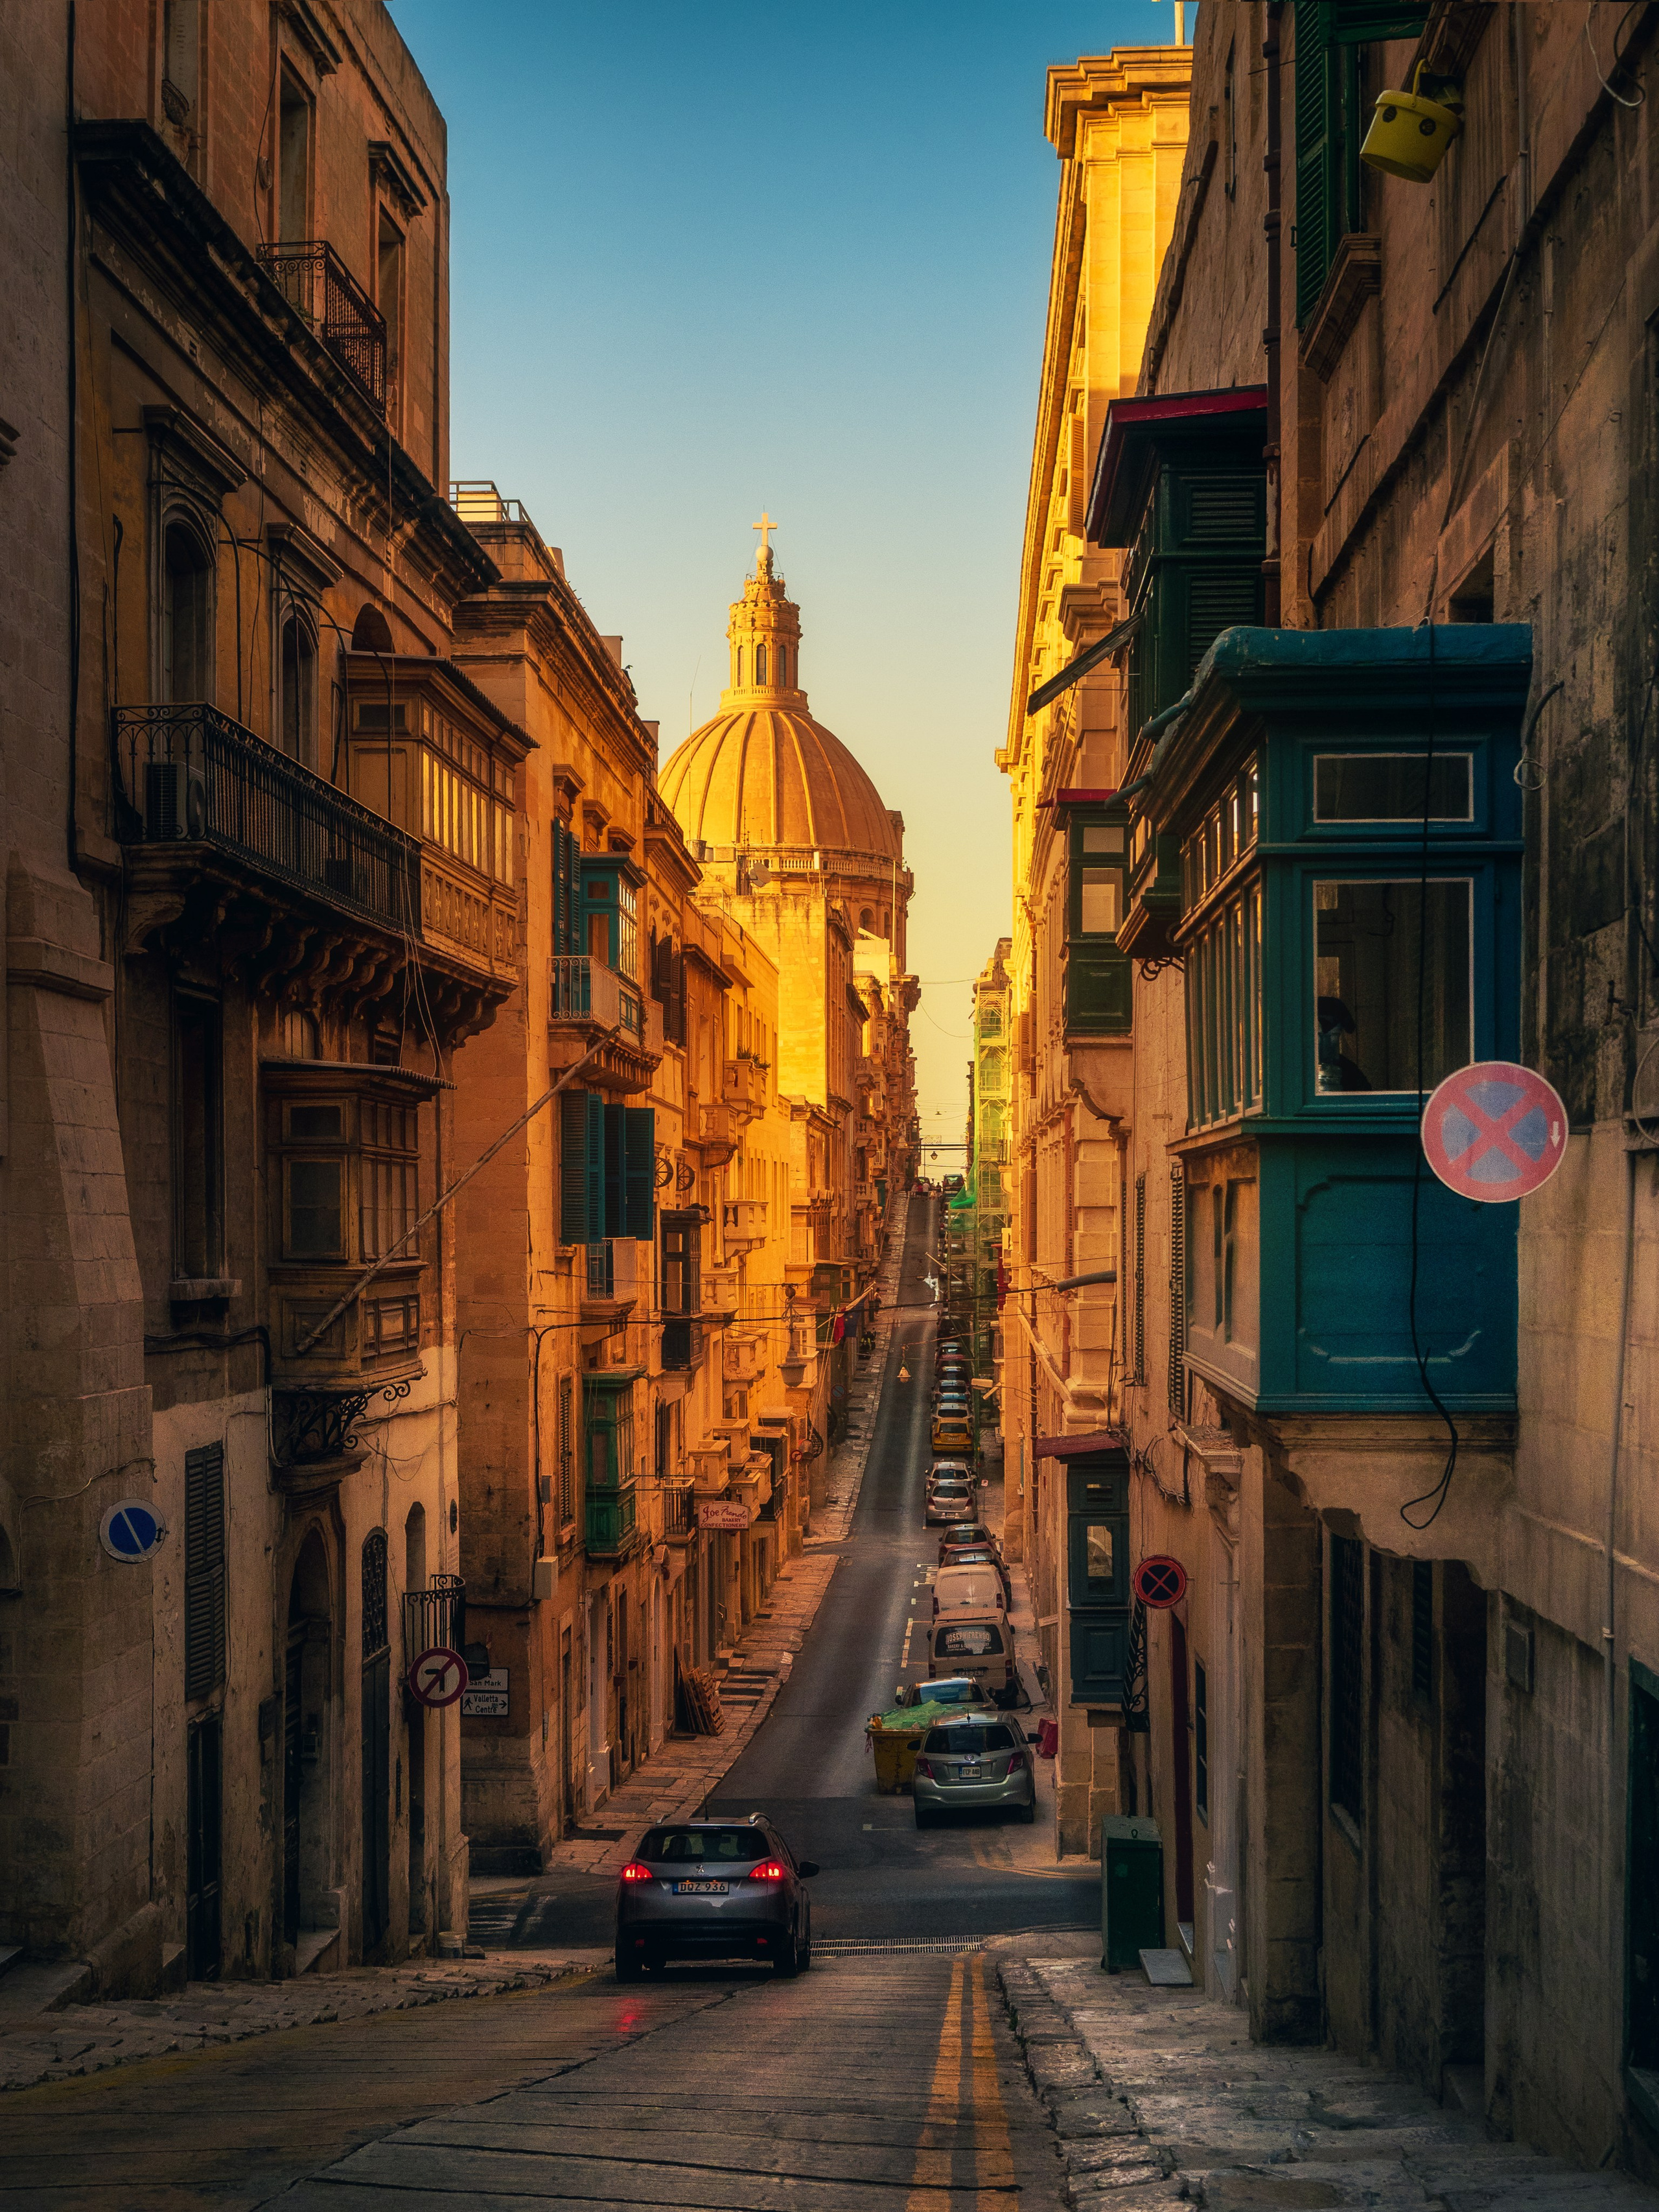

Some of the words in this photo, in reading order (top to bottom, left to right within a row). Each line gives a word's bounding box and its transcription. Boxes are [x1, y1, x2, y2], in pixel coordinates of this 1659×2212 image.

[702, 1506, 719, 1522] Joe
[947, 1631, 967, 1643] JOSEPH
[475, 1705, 497, 1714] Centre
[680, 1883, 701, 1891] DQZ
[705, 1883, 725, 1891] 936
